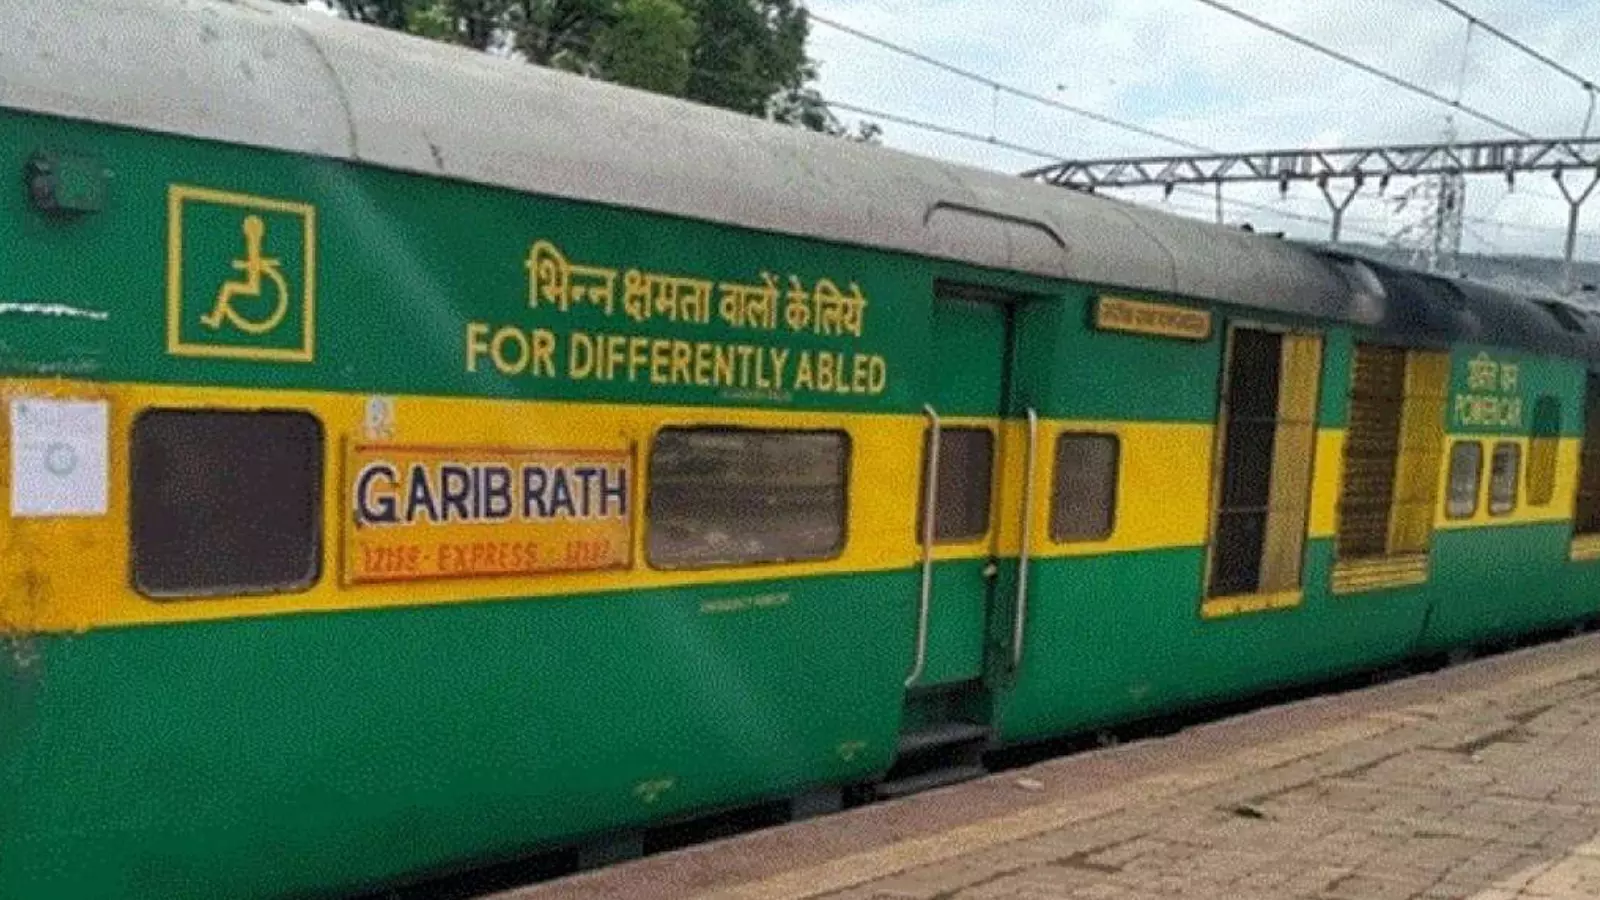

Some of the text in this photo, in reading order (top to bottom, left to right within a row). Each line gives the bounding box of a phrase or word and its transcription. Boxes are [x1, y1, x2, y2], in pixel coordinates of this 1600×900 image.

[524, 239, 616, 315] भिन्न
[624, 268, 712, 323] क्षमता
[719, 271, 780, 329] वालों
[465, 321, 887, 395] FOR DIFFERENTLY ABLED
[356, 463, 628, 524] GARIB RATH
[436, 541, 539, 571] EXPRESS
